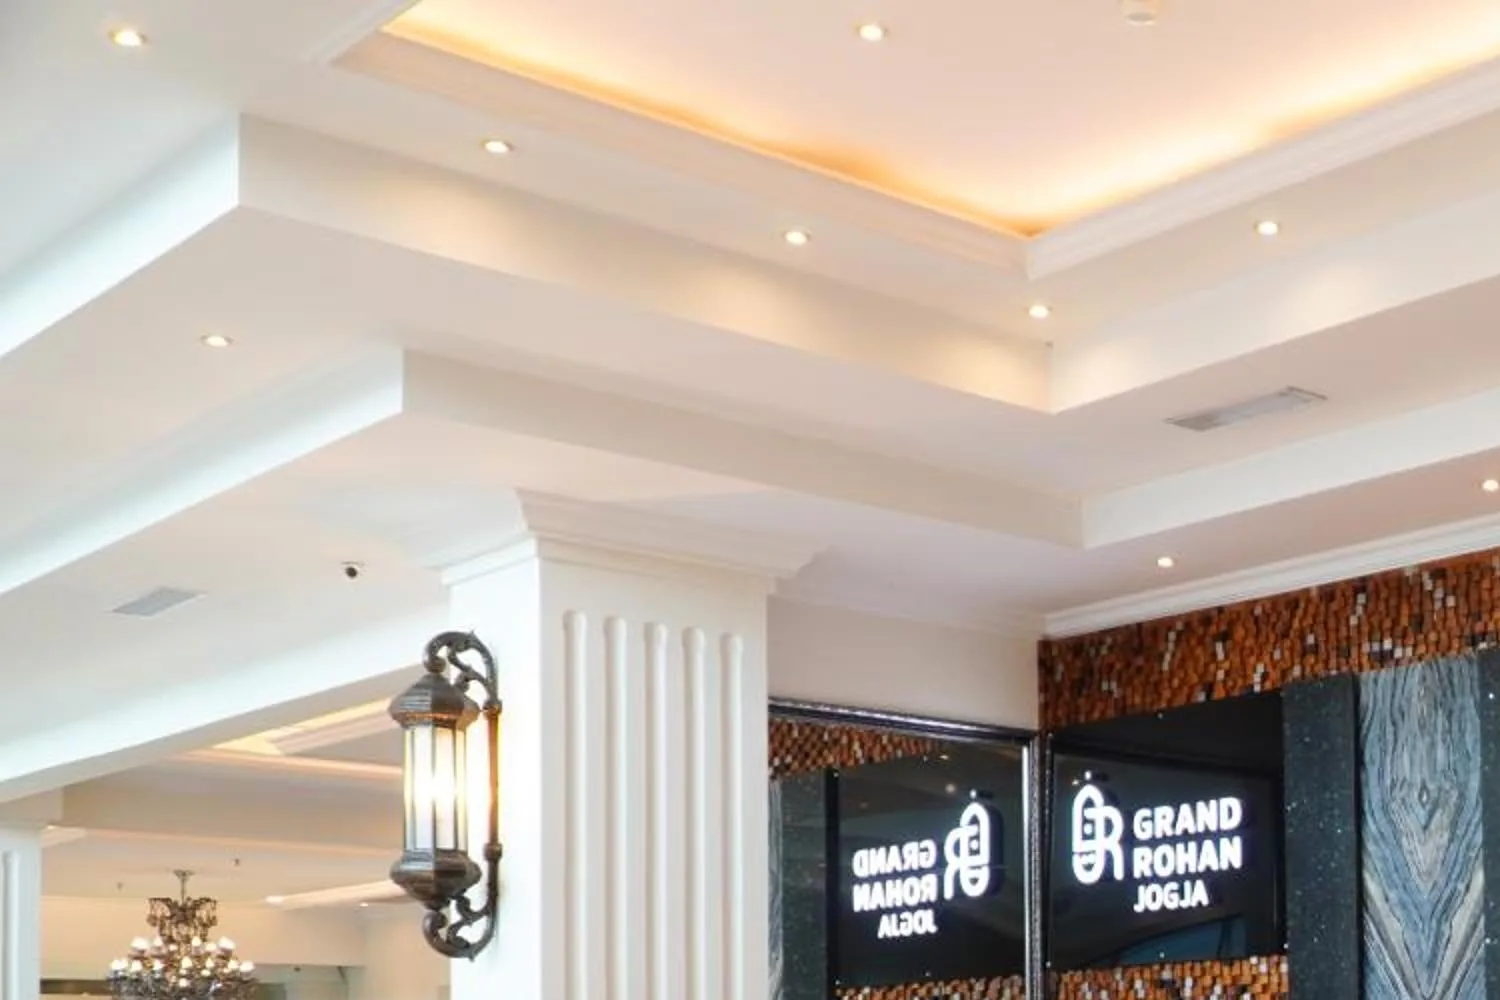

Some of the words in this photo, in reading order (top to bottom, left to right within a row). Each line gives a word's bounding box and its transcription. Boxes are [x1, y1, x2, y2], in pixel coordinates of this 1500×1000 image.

[1132, 796, 1243, 841] GRAND
[1132, 835, 1243, 879] ROHAN
[1132, 879, 1209, 913] JOGJA
